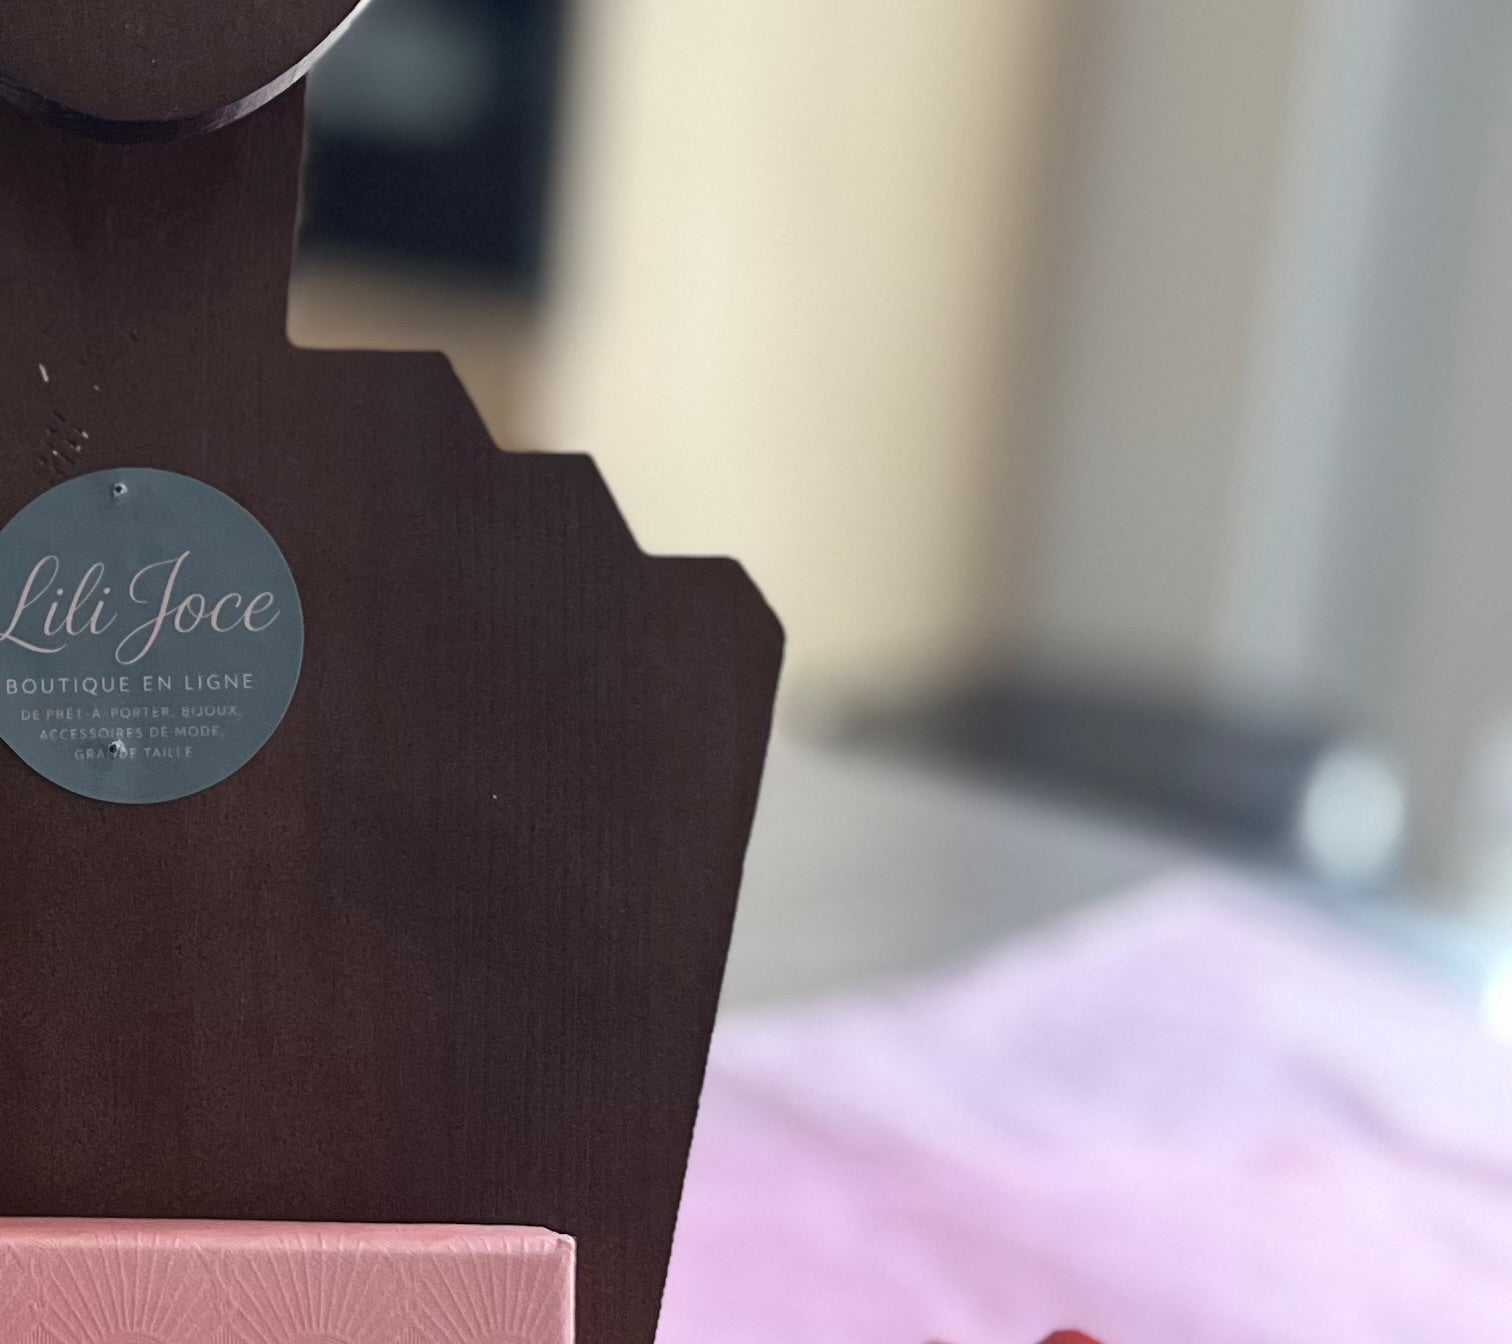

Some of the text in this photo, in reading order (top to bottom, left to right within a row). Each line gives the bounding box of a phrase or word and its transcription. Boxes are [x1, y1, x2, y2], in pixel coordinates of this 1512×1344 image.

[114, 549, 281, 666] Joce
[5, 672, 255, 696] BOUTIQUE EN LIGNE
[20, 709, 40, 721] DE
[39, 726, 143, 740] ACCESSOIRES
[149, 726, 168, 738] DE
[143, 745, 193, 759] TAILLE
